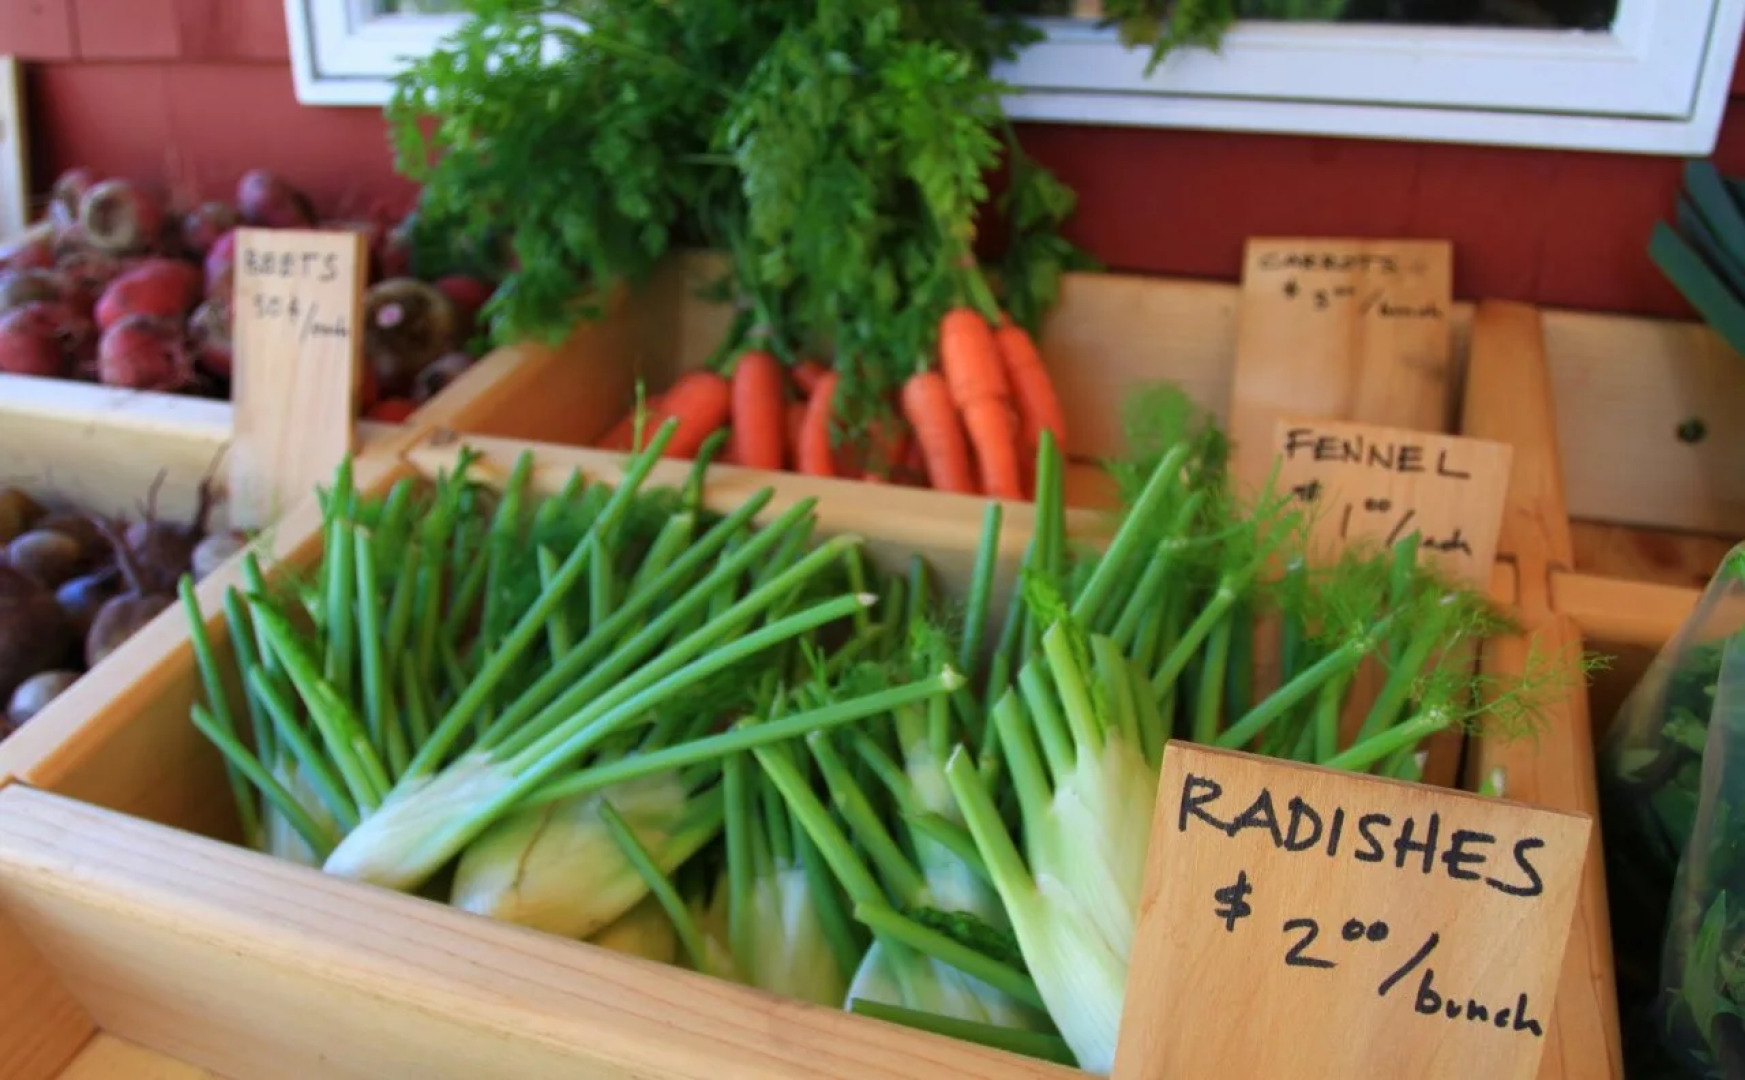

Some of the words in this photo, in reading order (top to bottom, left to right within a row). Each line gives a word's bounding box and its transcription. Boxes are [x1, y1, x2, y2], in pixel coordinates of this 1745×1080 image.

[244, 249, 339, 281] BEETS
[1285, 428, 1471, 479] FENNEL
[1178, 773, 1545, 897] RADISHES
[1214, 871, 1253, 931] $
